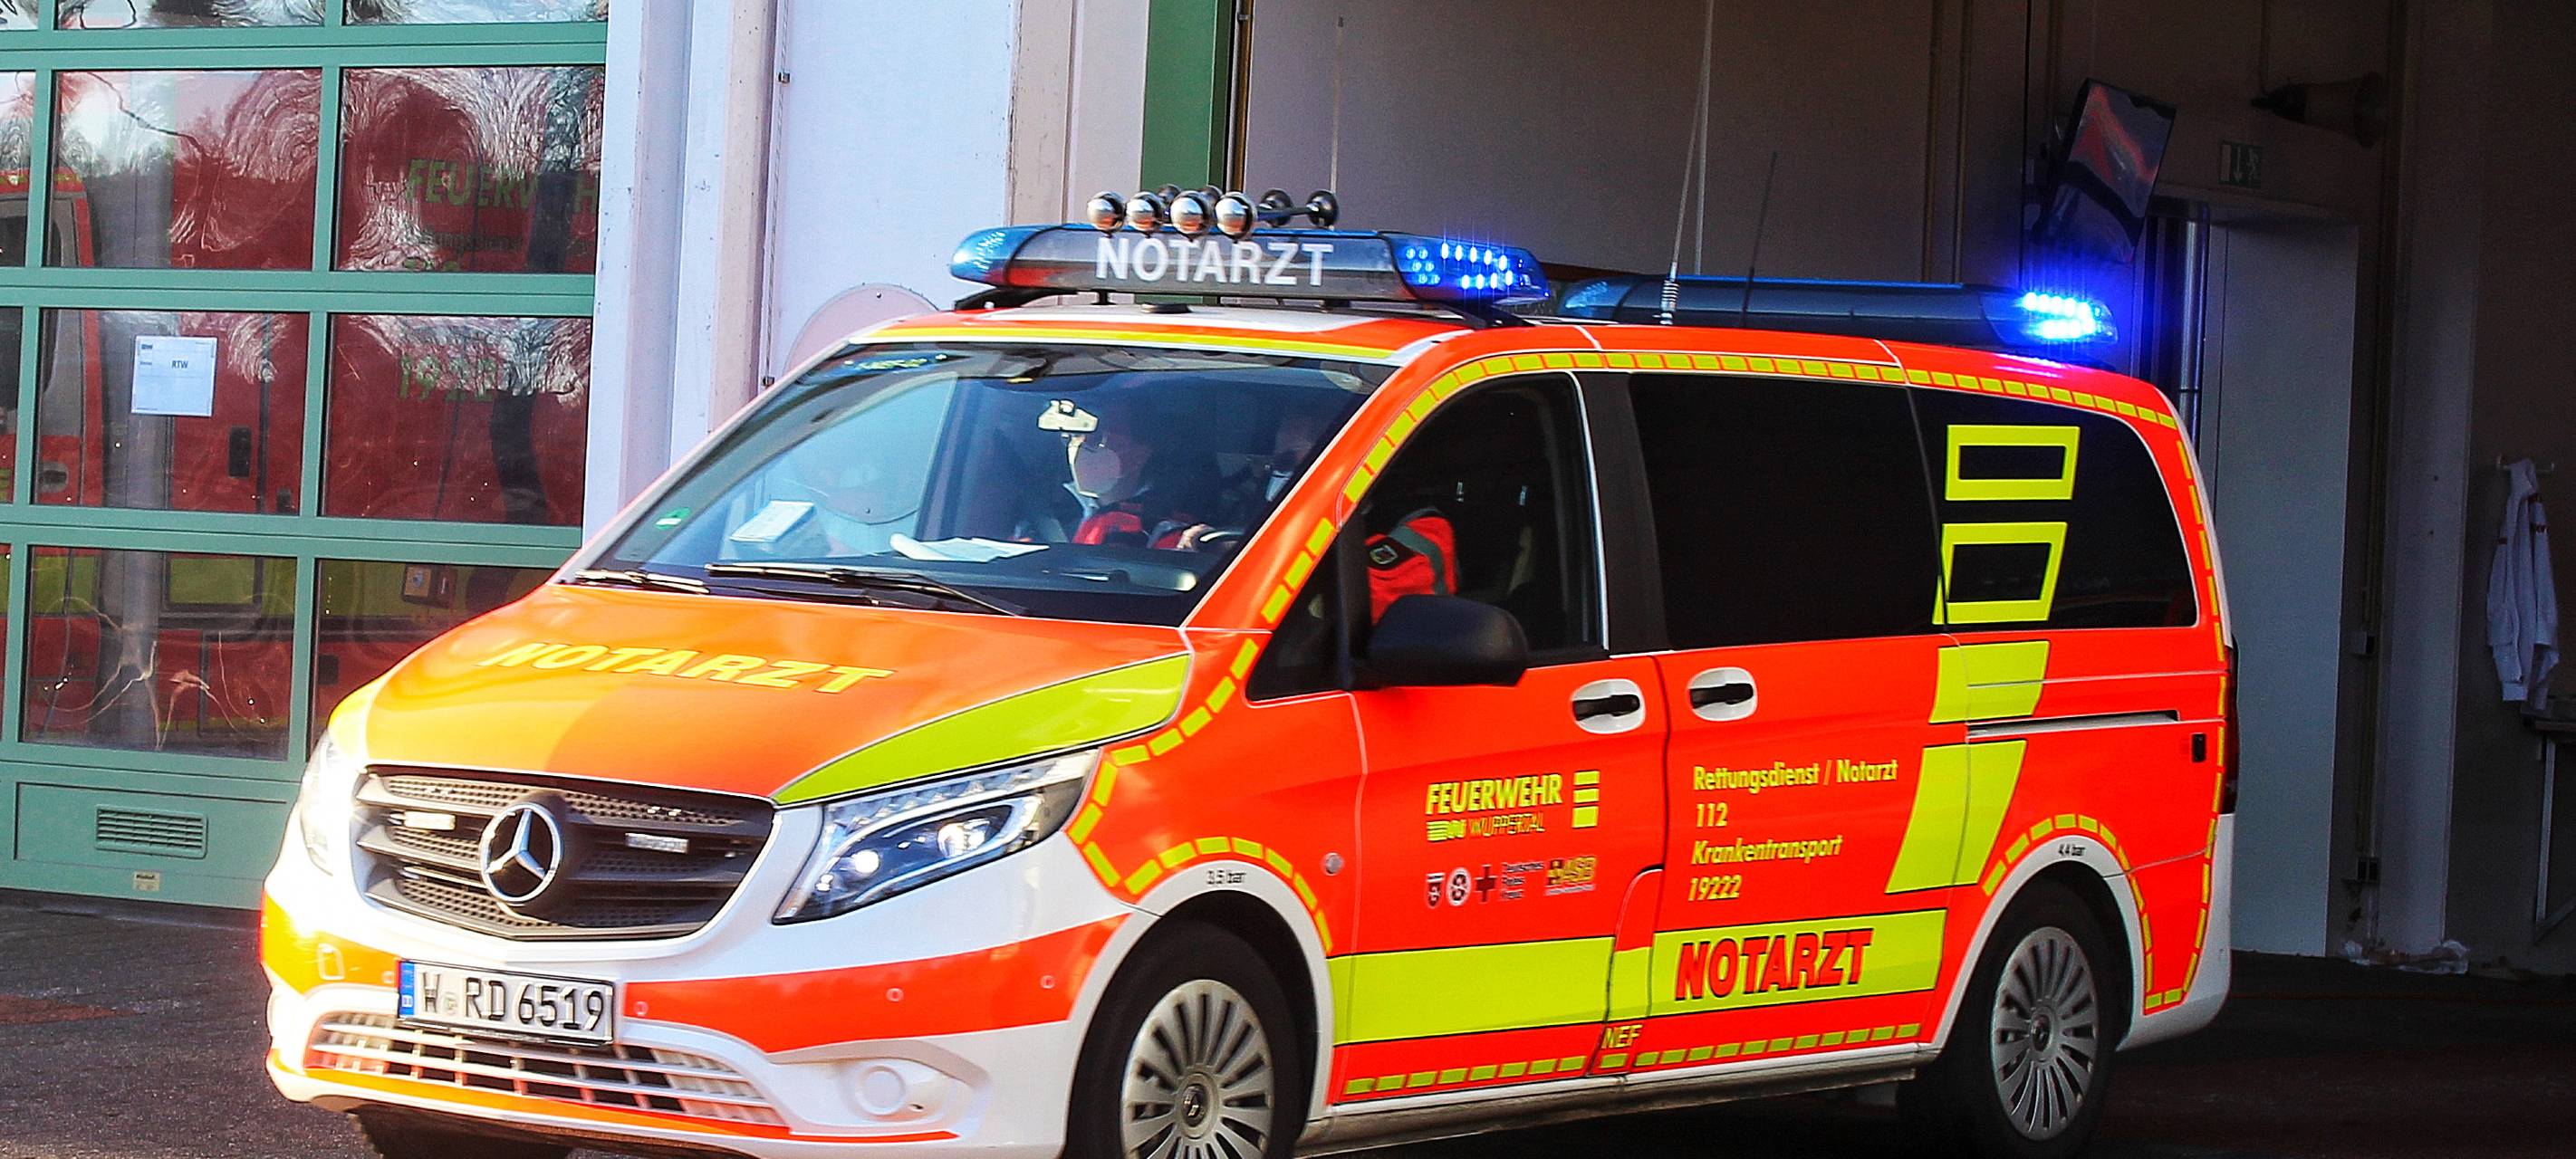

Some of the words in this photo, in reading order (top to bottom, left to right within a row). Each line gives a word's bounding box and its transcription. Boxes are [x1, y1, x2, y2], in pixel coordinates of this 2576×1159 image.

[1096, 236, 1334, 287] NOTARZT
[171, 360, 189, 369] RTW
[477, 642, 895, 694] NOTARZT
[1693, 761, 1821, 794] Rettungsdienst
[1836, 759, 1898, 783] Notarzt
[1425, 773, 1563, 814] FEUERWEHR
[1468, 812, 1545, 837] WUPPERTAL
[1697, 802, 1728, 828] 112
[1691, 835, 1843, 864] Krankentransport
[1688, 874, 1743, 902] 19222
[1675, 927, 1875, 1001] NOTARZT
[465, 977, 507, 1021] RD
[517, 982, 604, 1031] 6519
[1600, 1024, 1643, 1049] NEF
